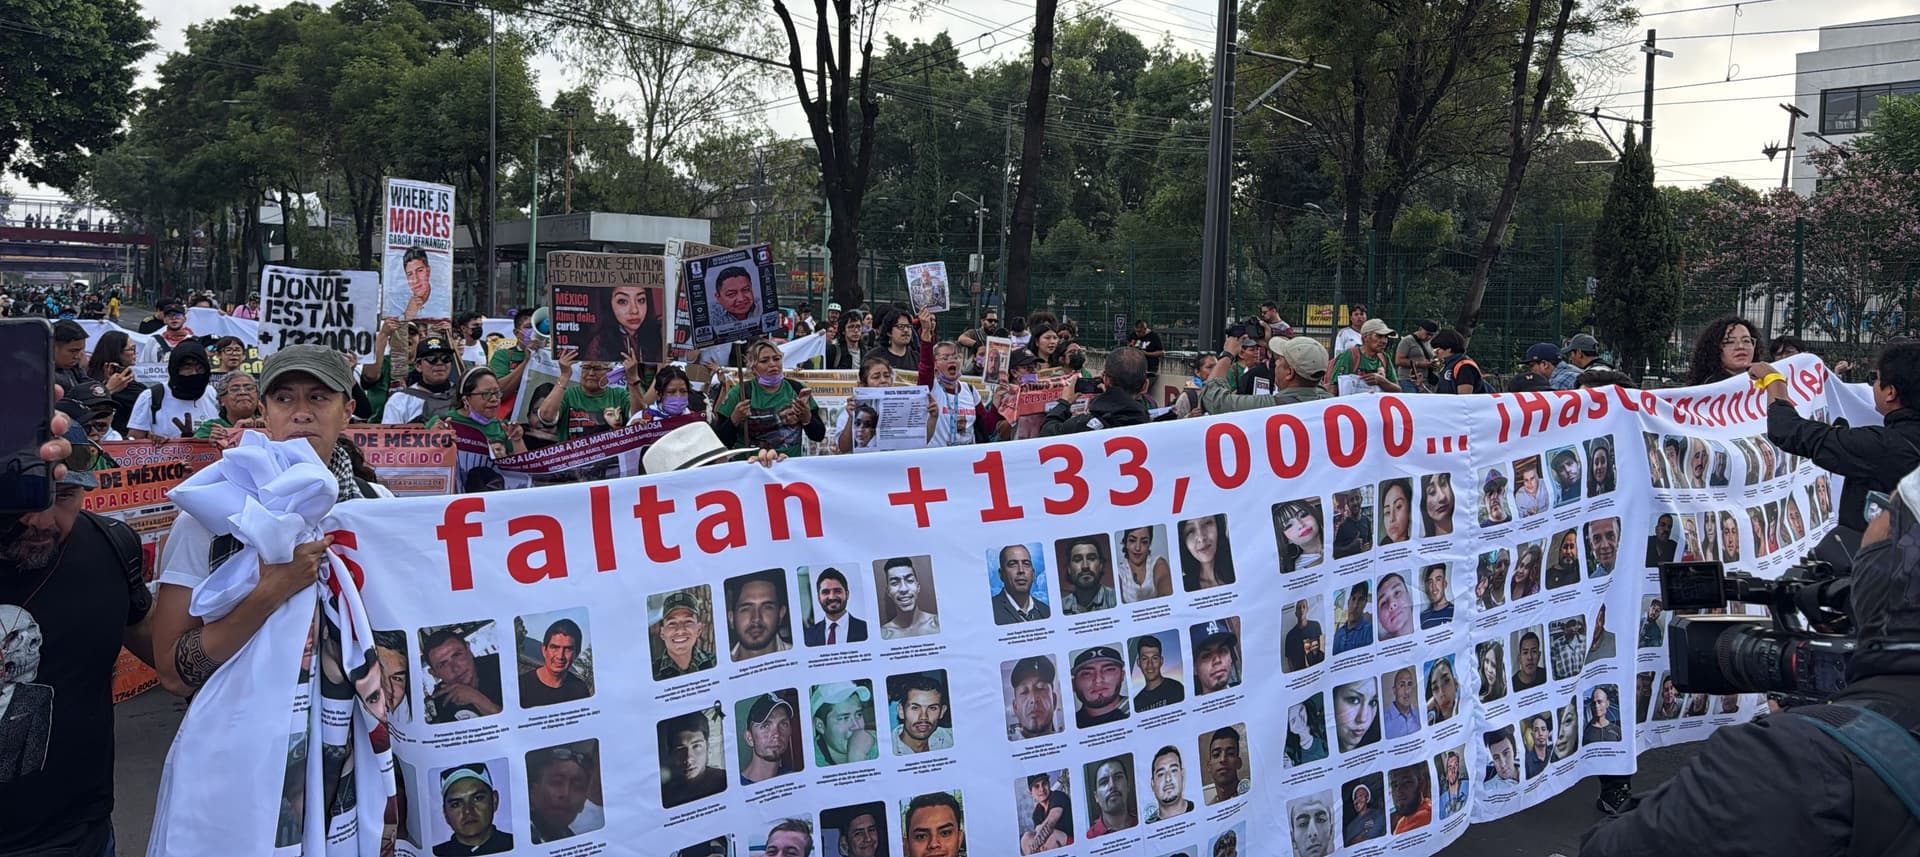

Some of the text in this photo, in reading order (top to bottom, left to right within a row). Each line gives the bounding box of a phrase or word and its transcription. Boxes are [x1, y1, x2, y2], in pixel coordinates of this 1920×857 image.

[390, 186, 434, 211] WHERE
[389, 208, 451, 239] MOISÉS
[389, 233, 411, 245] GARCÍA
[570, 270, 605, 283] FAMILY
[620, 272, 664, 284] WAITING
[575, 256, 611, 270] ANYONE
[616, 257, 641, 270] SEEN
[267, 274, 351, 302] DONDE
[265, 299, 354, 328] ESTAN
[354, 431, 453, 448] DE MÉXICO
[524, 445, 565, 462] LOCALIZAR
[572, 440, 589, 451] JOEL
[625, 427, 635, 435] DE
[100, 462, 185, 490] DE MÉXICO
[436, 480, 825, 591] faltan
